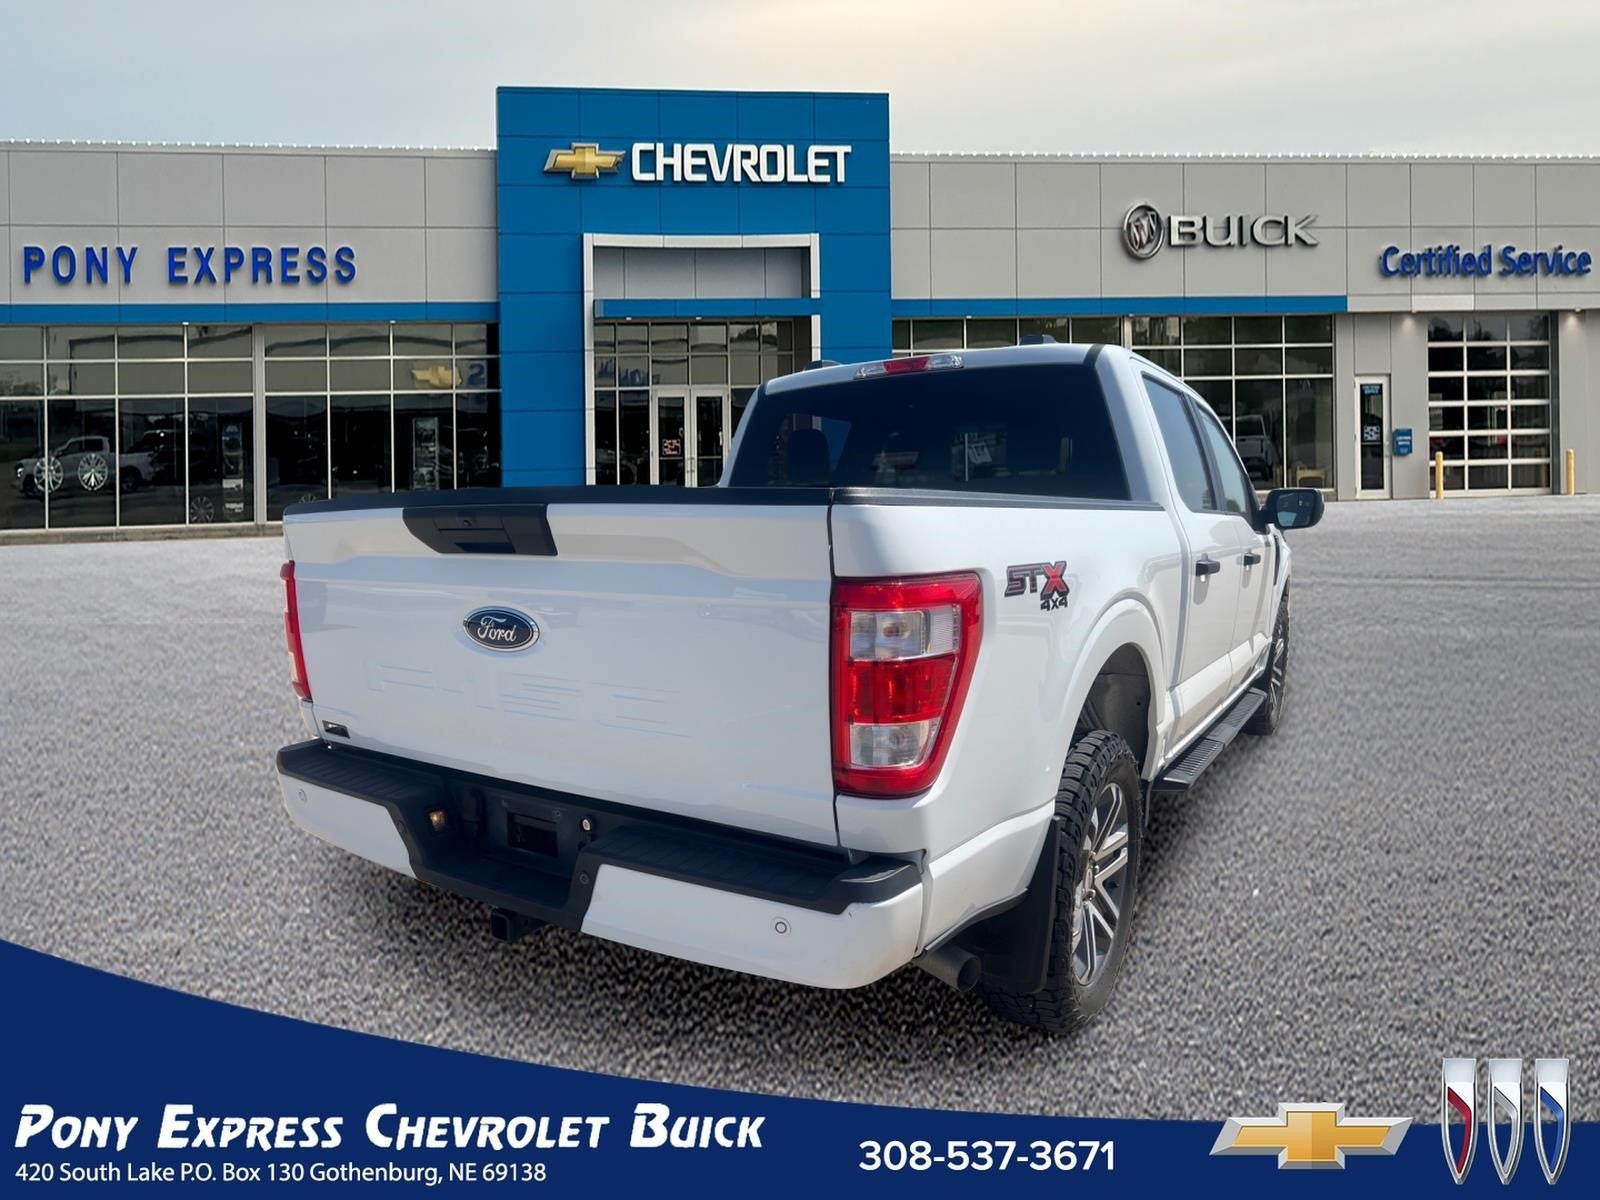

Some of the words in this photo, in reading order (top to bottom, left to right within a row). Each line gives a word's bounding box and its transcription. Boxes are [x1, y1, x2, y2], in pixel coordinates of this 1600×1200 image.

[631, 142, 852, 184] CHEVROLET
[1168, 214, 1320, 247] BUICK
[23, 245, 138, 285] PONY
[167, 245, 357, 285] EXPRESS
[1380, 244, 1493, 278] Certified
[1499, 244, 1592, 277] Service
[1004, 560, 1070, 600] STX
[477, 615, 517, 642] Ford
